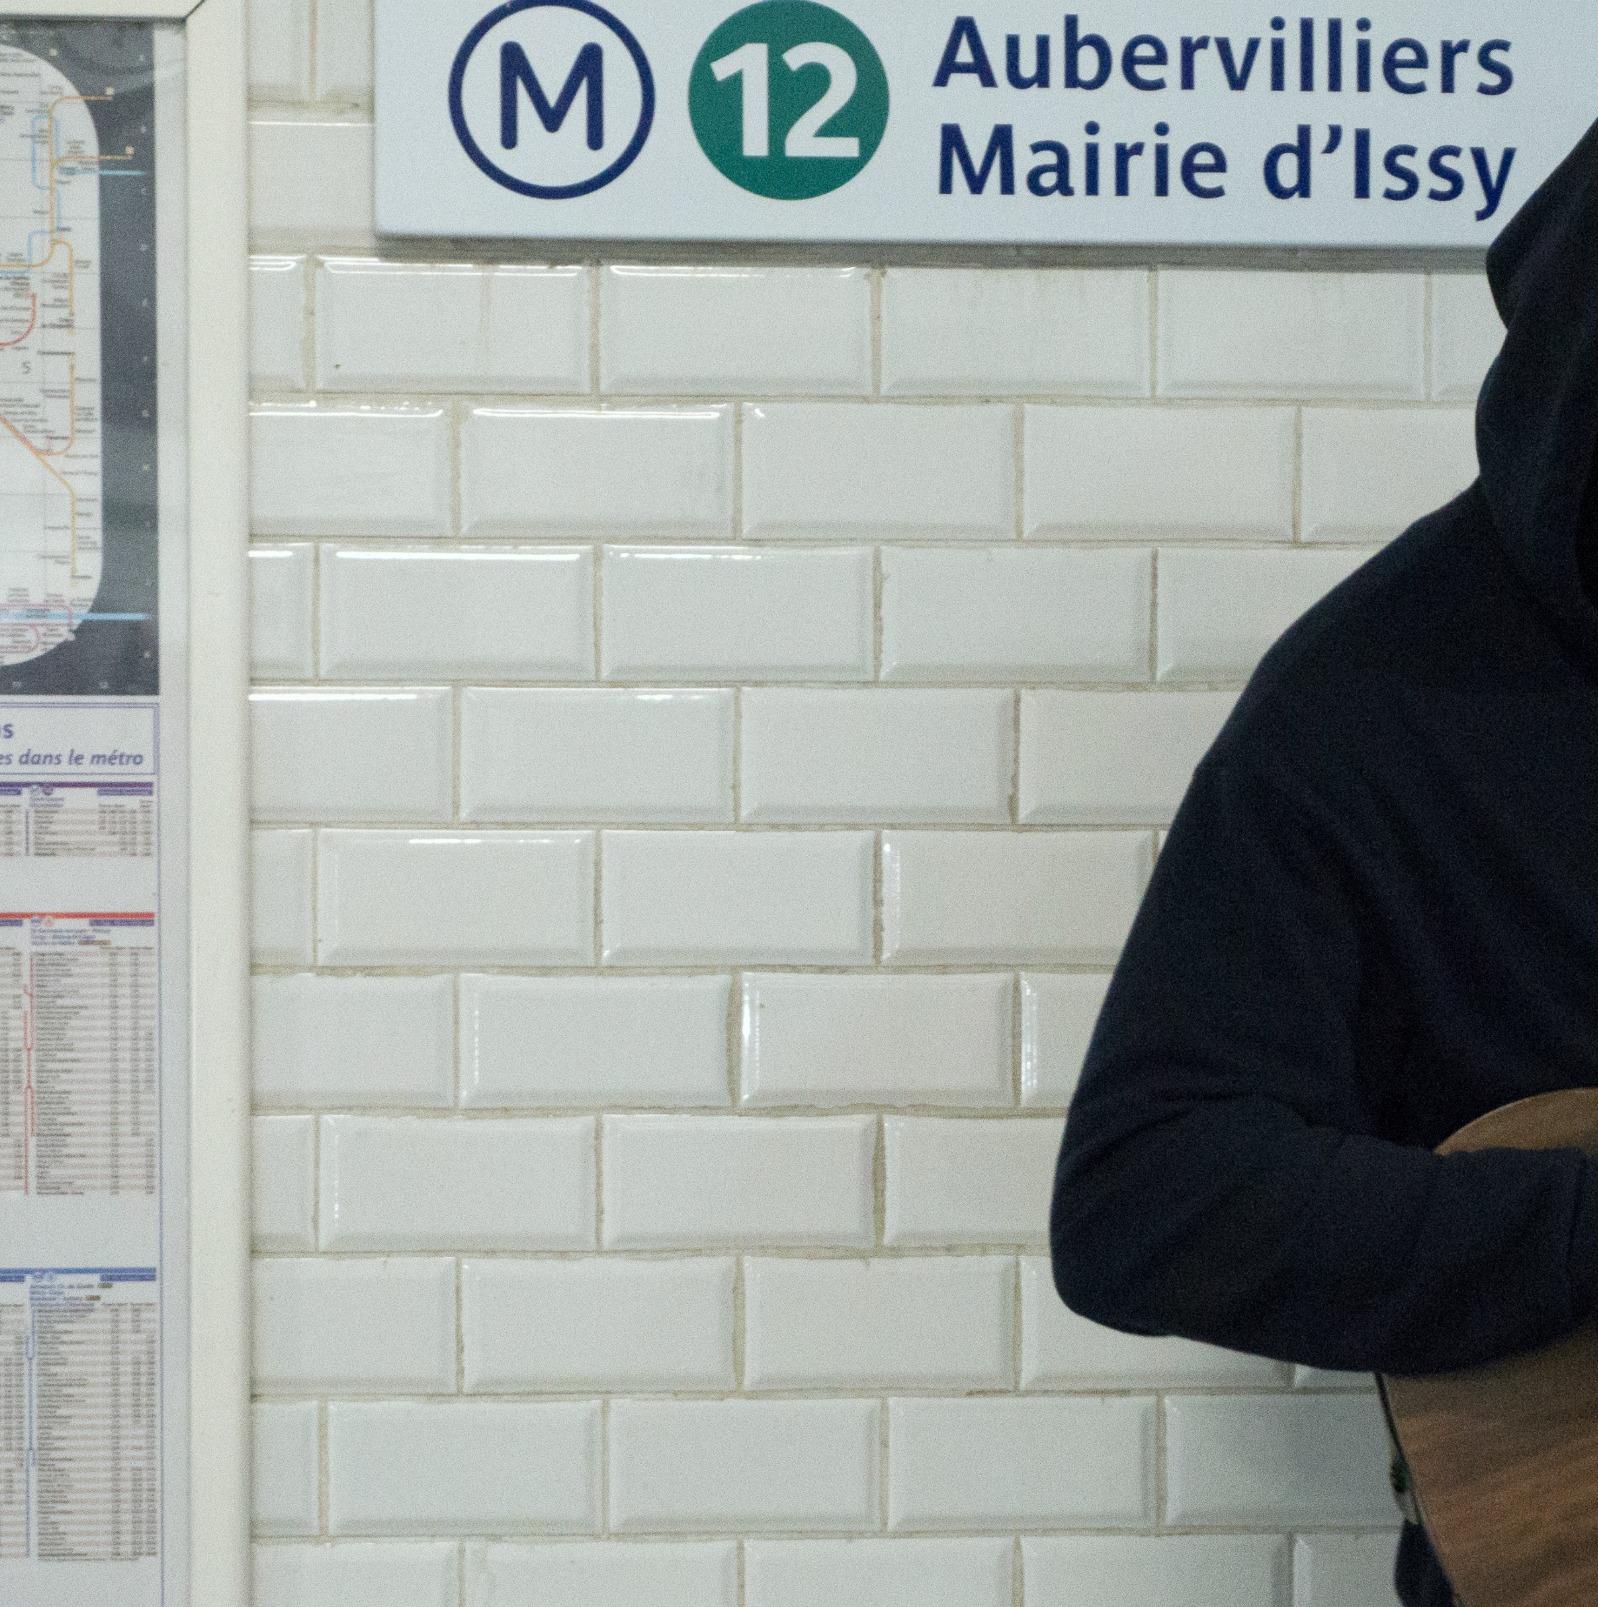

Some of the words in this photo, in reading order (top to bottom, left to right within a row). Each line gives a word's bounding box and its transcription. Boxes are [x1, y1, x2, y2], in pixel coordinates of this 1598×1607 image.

[500, 41, 604, 151] M
[709, 42, 860, 157] 12
[931, 14, 1514, 96] Aubervilliers
[938, 120, 1228, 200] Mairie
[1263, 124, 1517, 222] d’Issy
[18, 748, 62, 765] dans
[69, 748, 85, 765] le
[90, 749, 143, 766] métro
